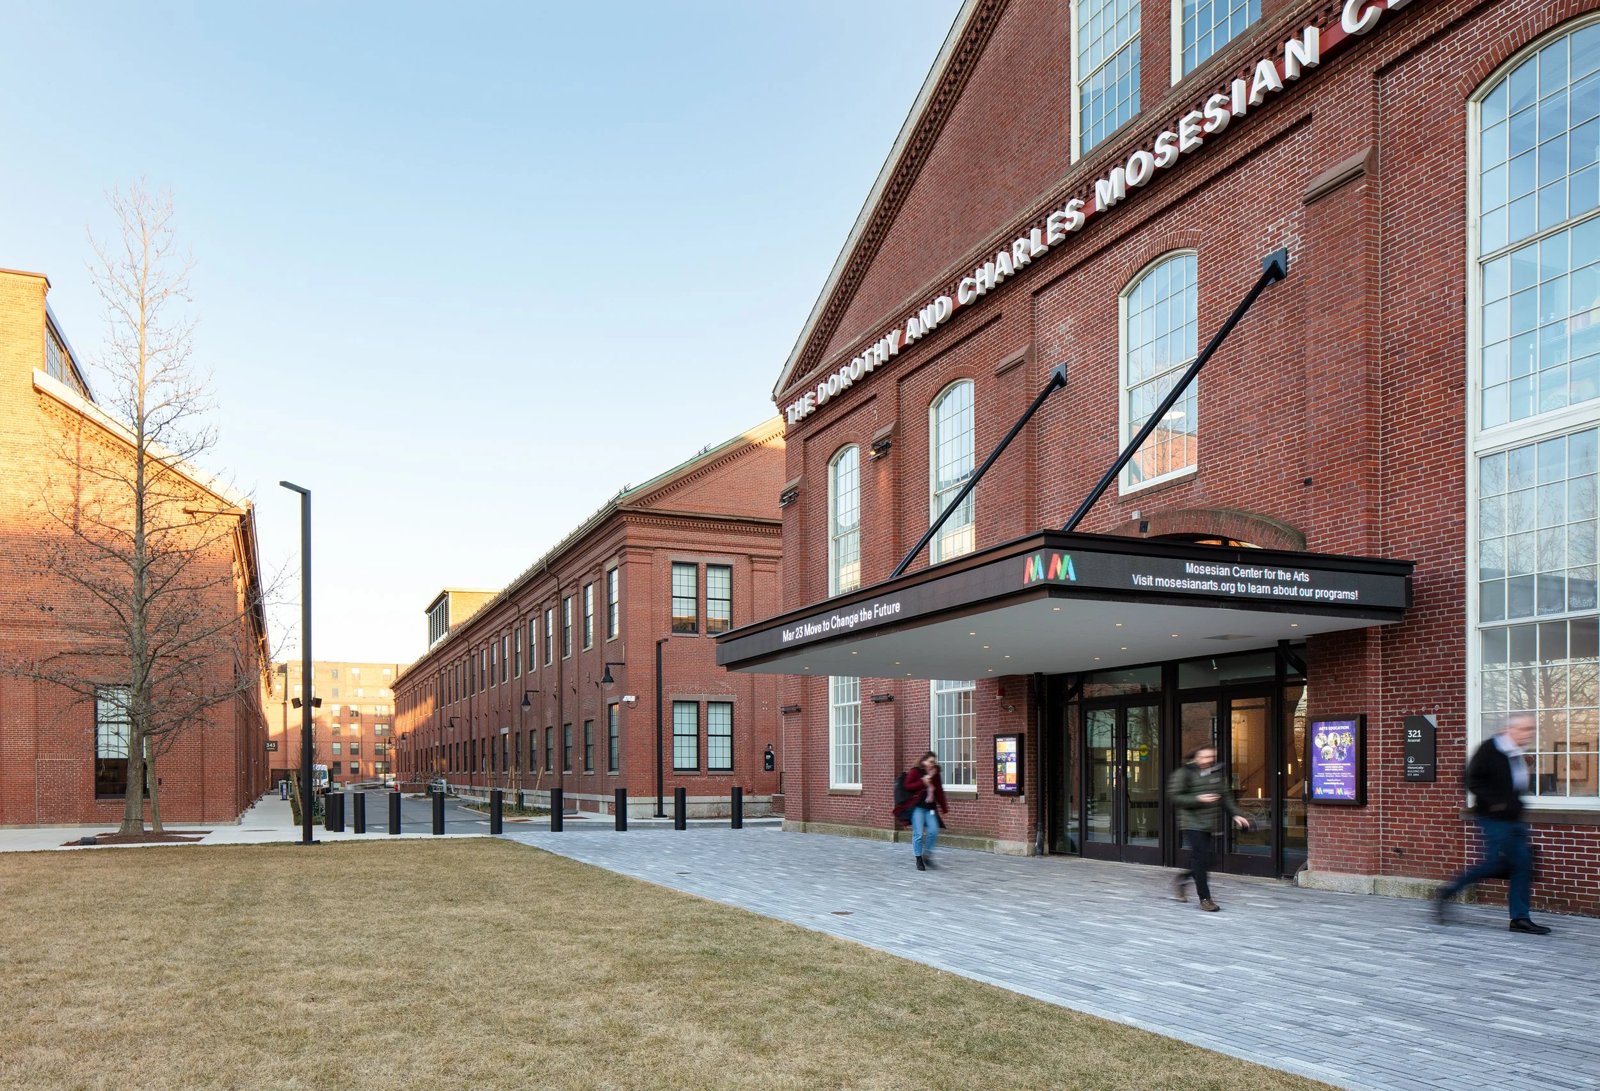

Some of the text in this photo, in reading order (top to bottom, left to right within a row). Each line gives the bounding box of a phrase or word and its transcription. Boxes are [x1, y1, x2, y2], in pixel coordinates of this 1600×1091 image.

[786, 0, 1414, 425] THE DOROTHY AND CHARLES MOSESIAN C
[1186, 562, 1310, 583] Mosesian Center for the Arts
[1132, 574, 1359, 601] Visit mosesianarts.org to learn about our programs!
[782, 602, 901, 642] Mar 23 Move to Change the Future
[1407, 729, 1422, 738] 321
